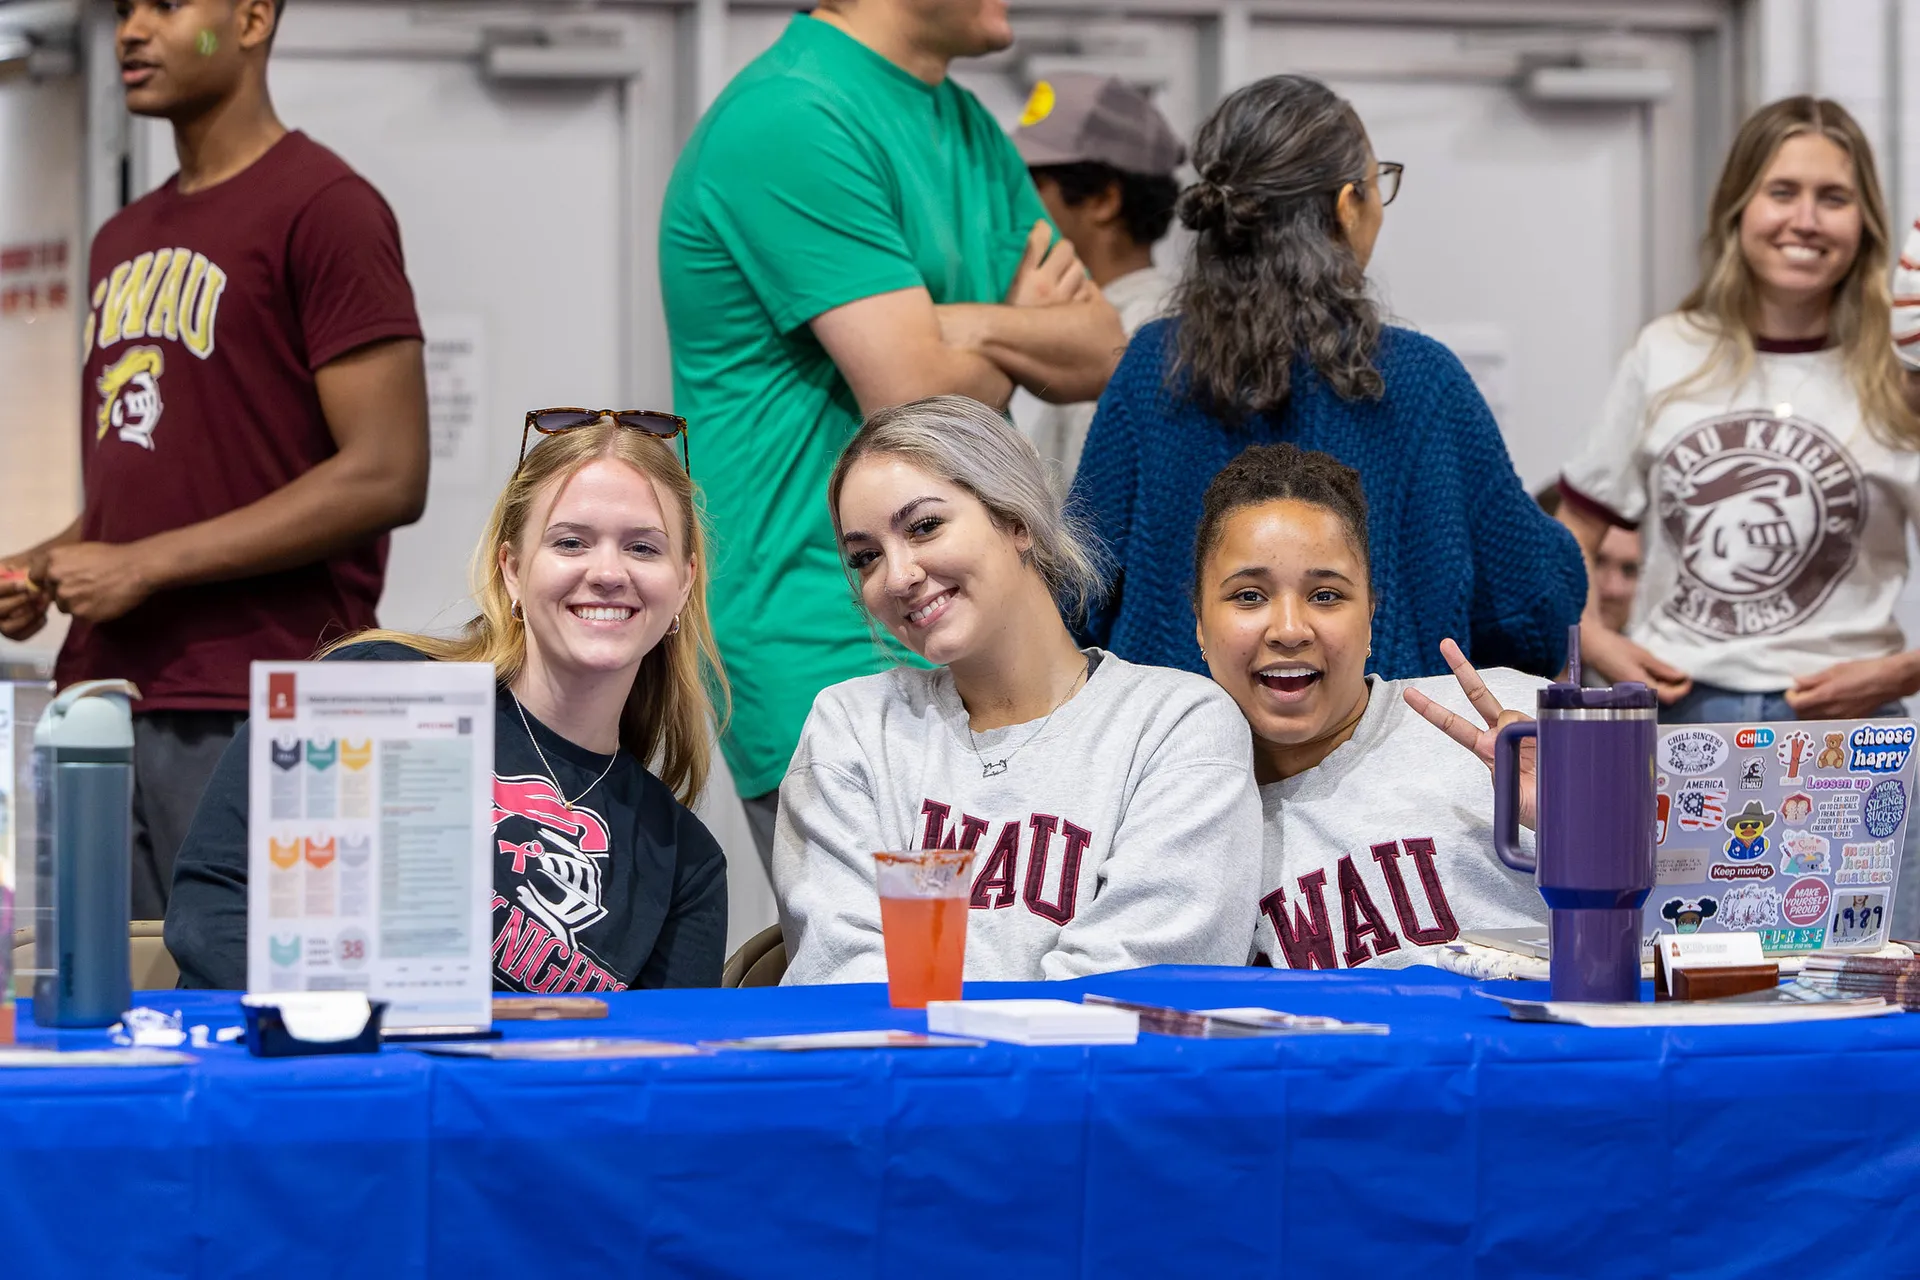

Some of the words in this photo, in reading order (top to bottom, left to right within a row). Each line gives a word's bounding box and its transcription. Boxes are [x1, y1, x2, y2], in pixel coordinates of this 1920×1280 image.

[1744, 420, 1858, 534] KNIGHTS
[1734, 591, 1797, 634] 1893
[1667, 732, 1691, 747] CHILL
[1739, 733, 1769, 745] CHILL
[1853, 727, 1912, 746] choose
[1854, 749, 1907, 769] happy
[1686, 780, 1723, 789] AMERICA
[1807, 777, 1852, 790] Loosen
[1854, 780, 1871, 791] up
[1875, 781, 1901, 793] WORK
[1867, 796, 1904, 812] SILENCE
[1866, 810, 1902, 824] SUCCESS
[1870, 825, 1894, 837] NOISE
[1844, 841, 1893, 857] mental
[1844, 857, 1890, 870] health
[1713, 866, 1736, 878] Keep
[1737, 865, 1771, 877] moving.
[1837, 870, 1892, 883] matters
[1794, 887, 1820, 897] MAKE
[1785, 896, 1829, 907] YOURSELF
[1789, 905, 1821, 915] PROUD.
[1833, 906, 1883, 933] 1989
[491, 889, 628, 993] NIGHT
[341, 939, 365, 960] 38
